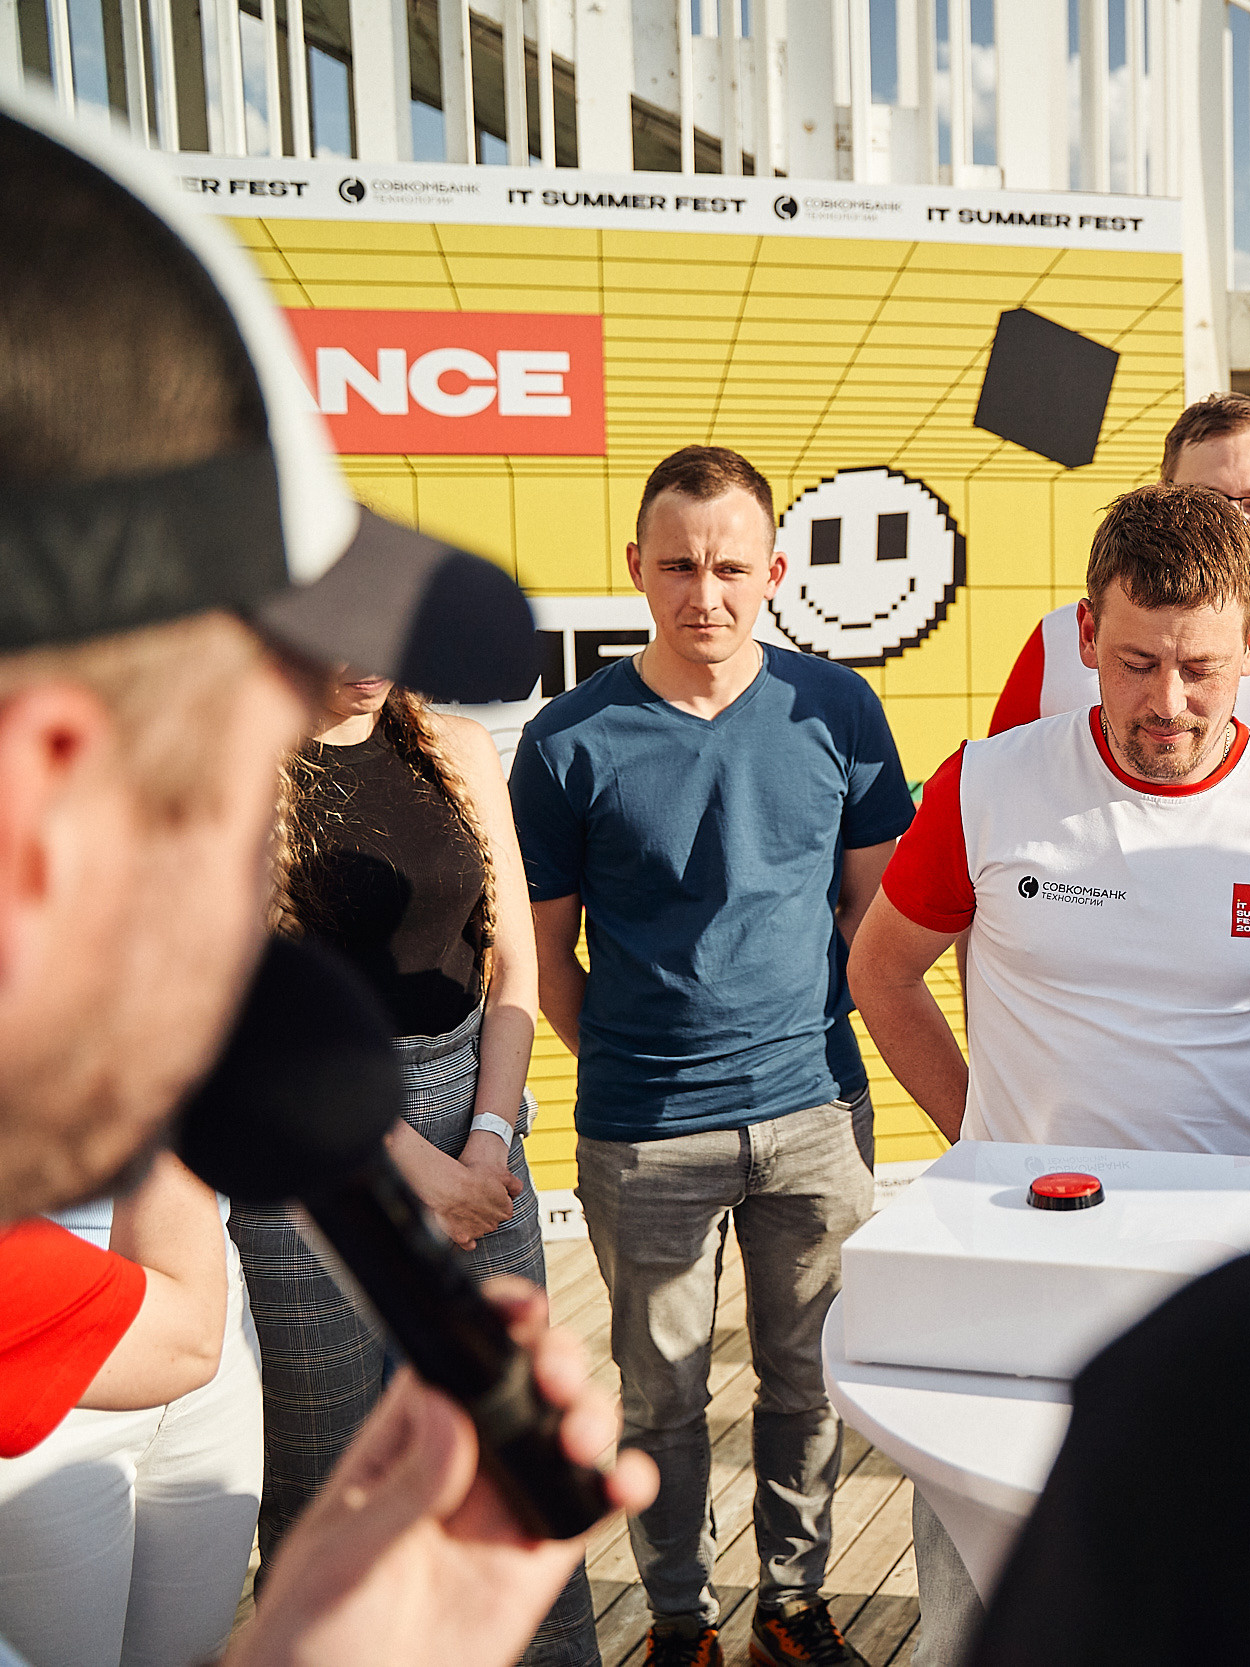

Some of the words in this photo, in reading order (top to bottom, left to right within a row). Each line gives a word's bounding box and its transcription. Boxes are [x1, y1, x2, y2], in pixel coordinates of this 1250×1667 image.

[229, 178, 309, 197] FEST
[507, 189, 533, 205] IT
[542, 190, 667, 211] SUMMER
[674, 195, 747, 213] FEST
[927, 207, 950, 222] IT
[958, 208, 1072, 228] SUMMER
[1078, 214, 1143, 232] FEST
[1041, 891, 1104, 908] ТЕХНОЛОГИИ
[1042, 881, 1127, 901] СОВКОМБАНК
[550, 1208, 573, 1224] IT
